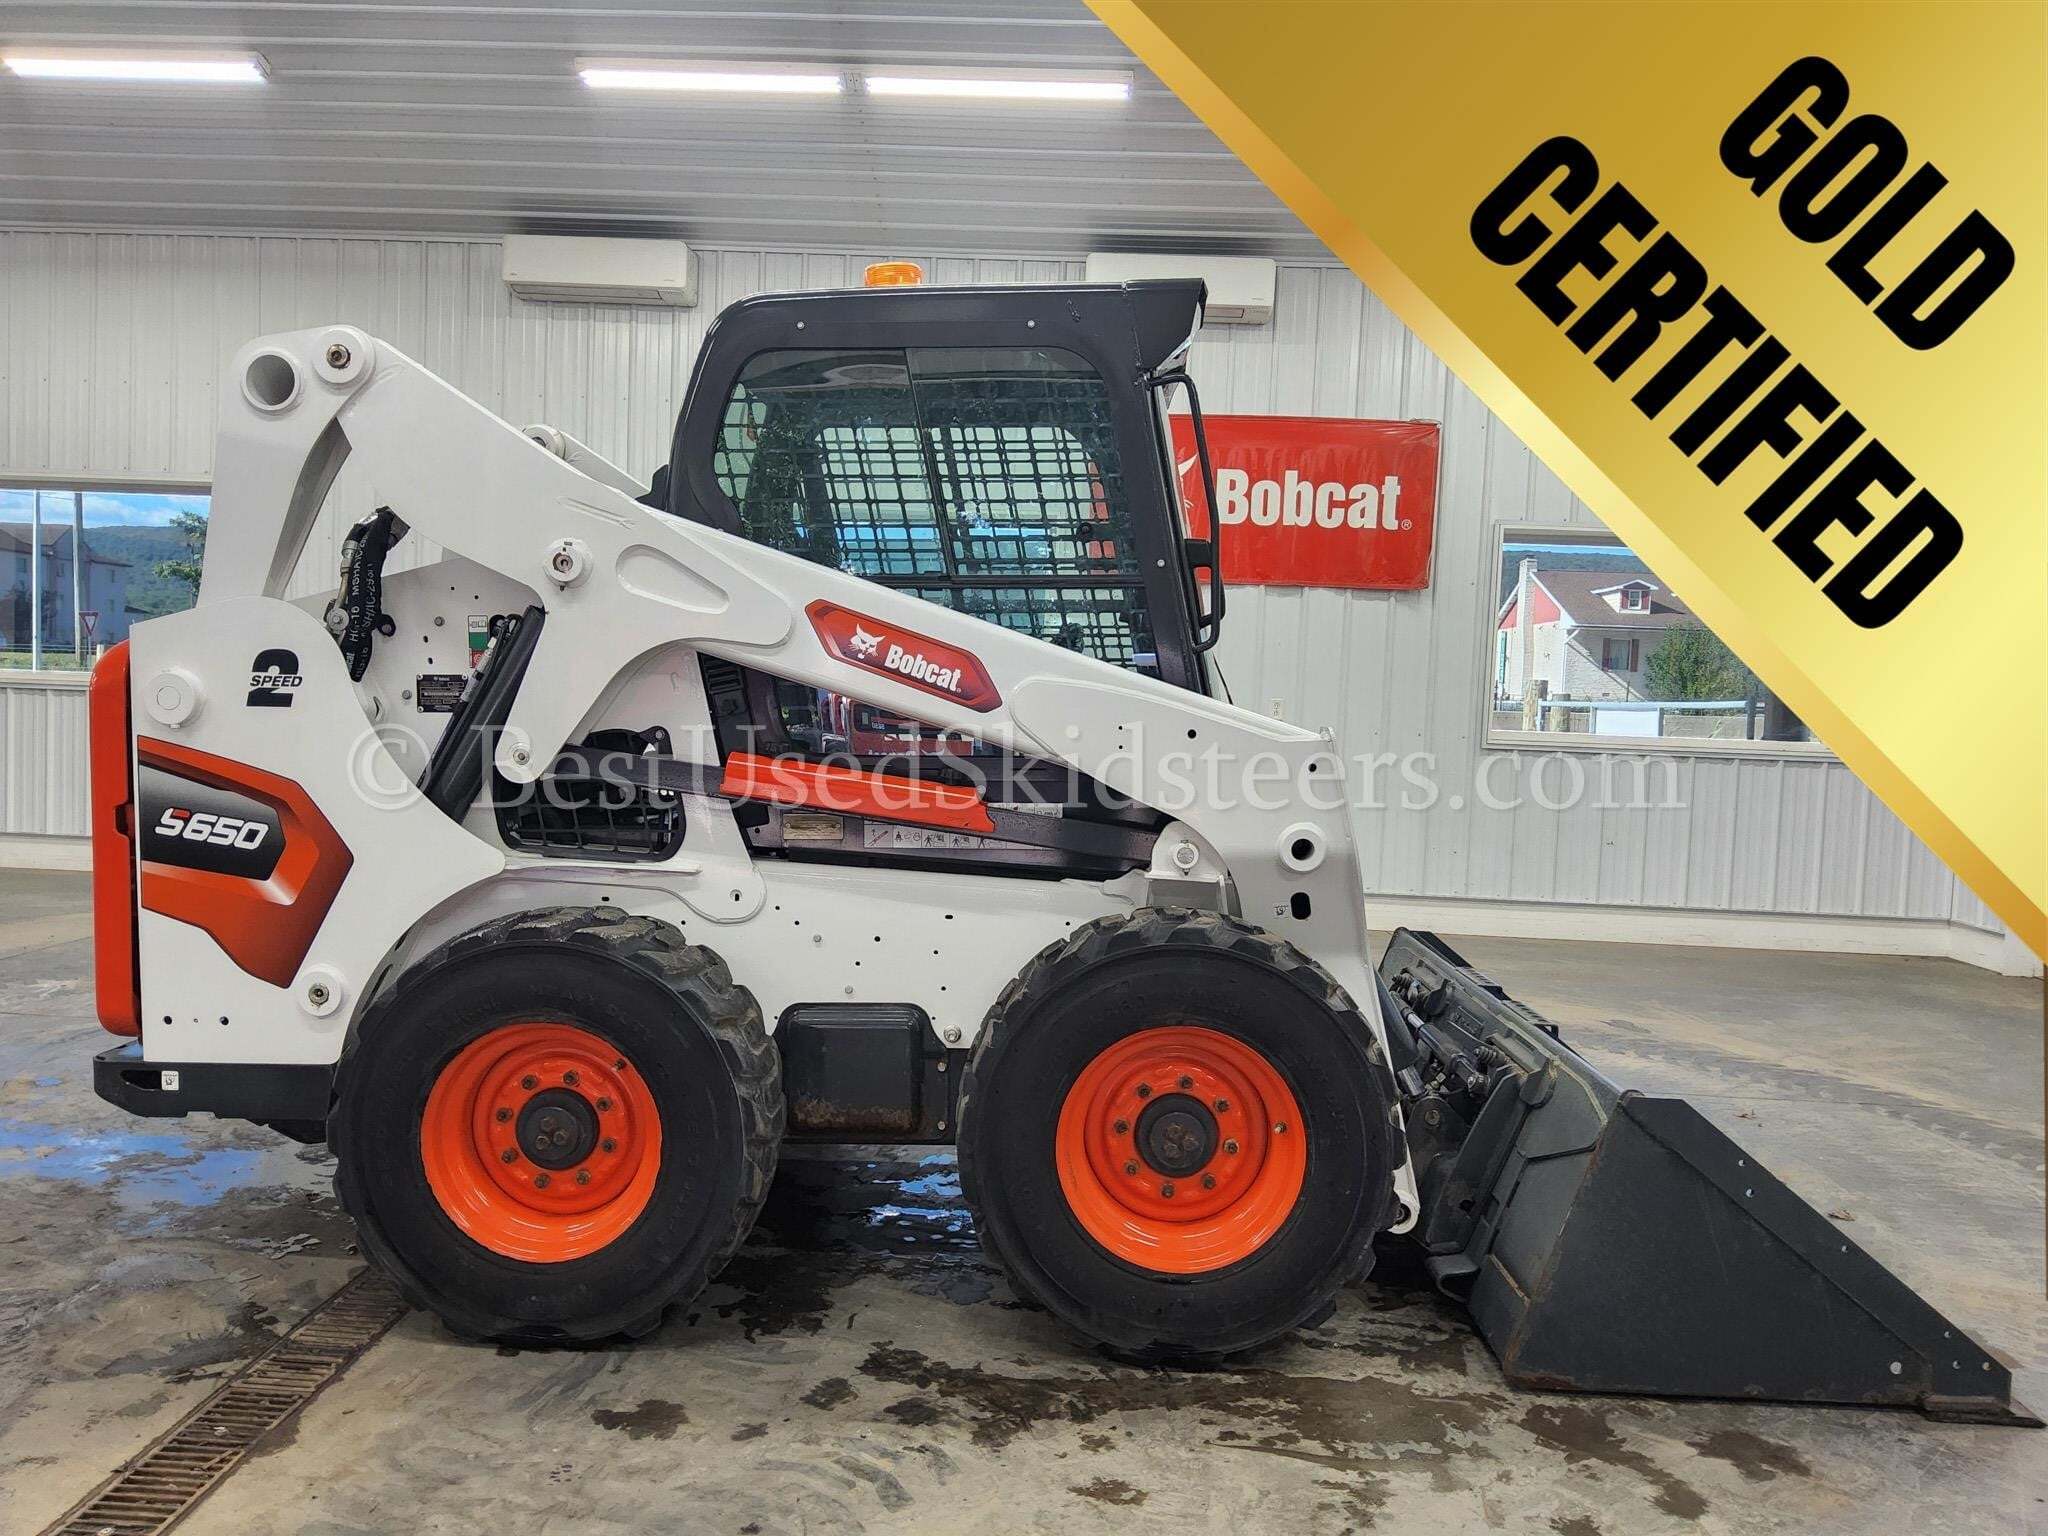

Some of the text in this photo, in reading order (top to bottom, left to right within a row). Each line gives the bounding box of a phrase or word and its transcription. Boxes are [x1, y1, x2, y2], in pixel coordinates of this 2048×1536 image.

[246, 648, 299, 708] 2
[249, 675, 303, 688] SPEED
[154, 807, 270, 850] S650
